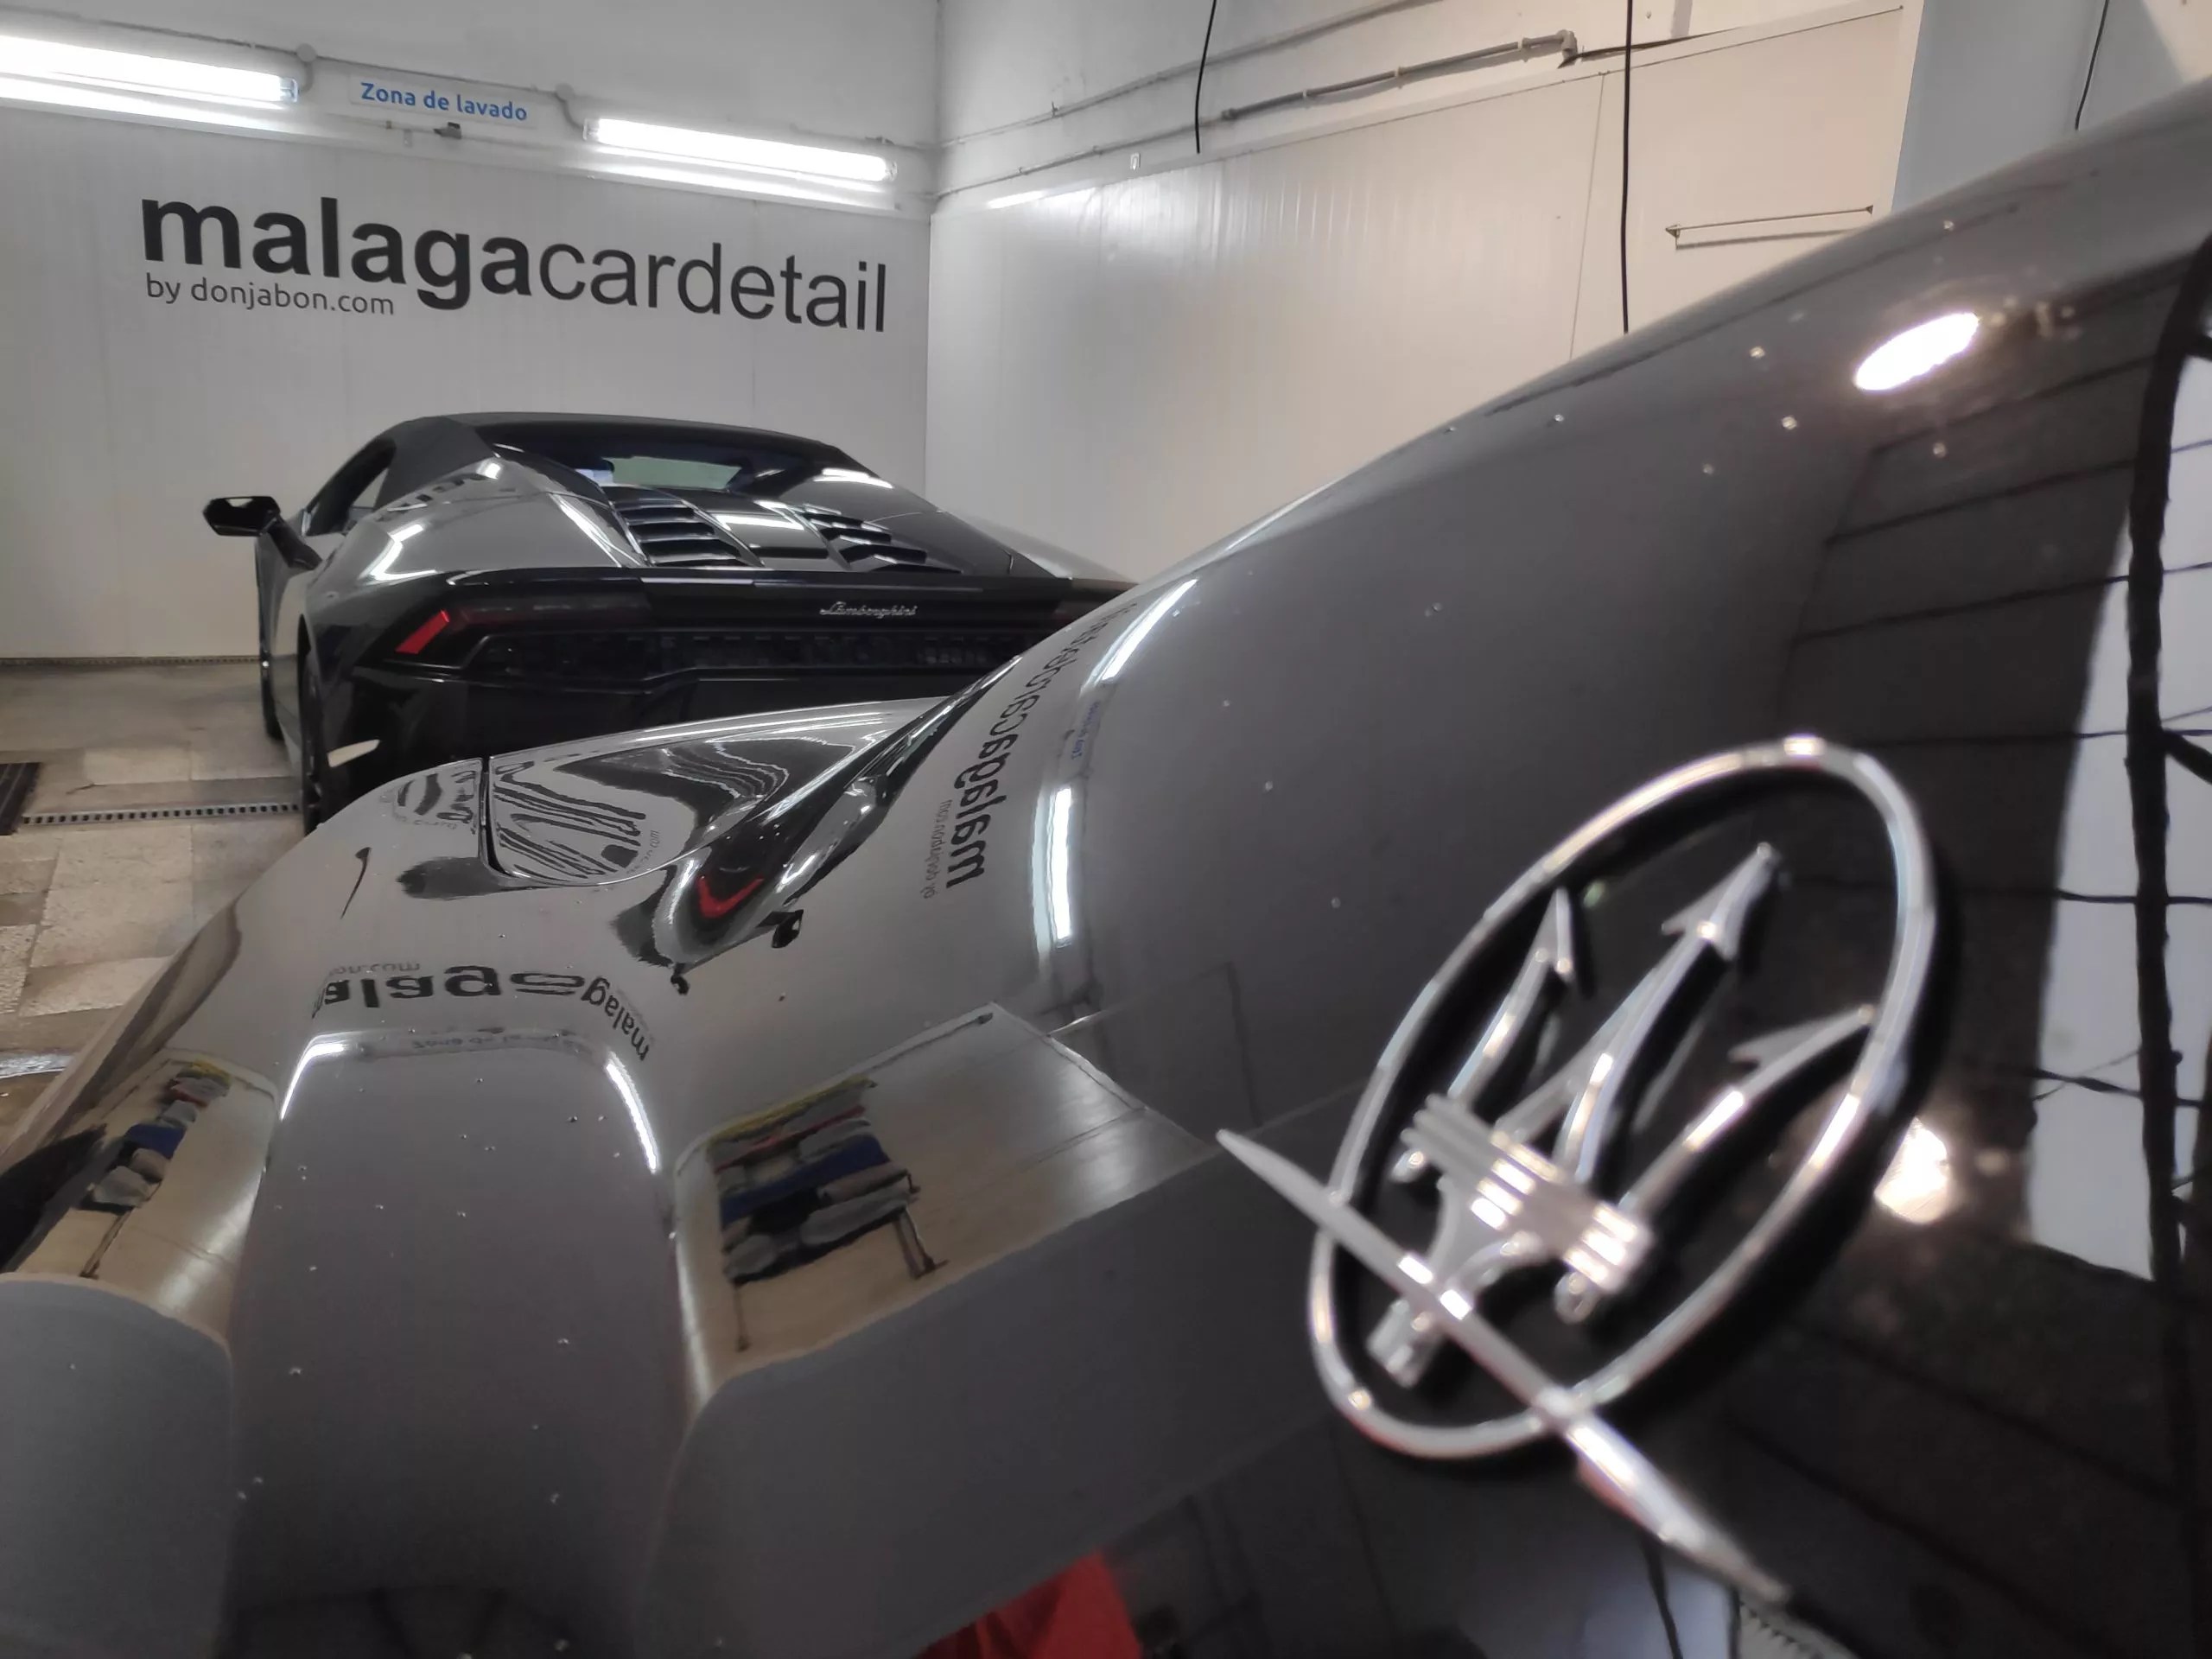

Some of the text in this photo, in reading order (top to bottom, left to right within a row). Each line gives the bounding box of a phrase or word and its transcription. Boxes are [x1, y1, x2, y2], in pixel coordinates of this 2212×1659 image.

[360, 82, 528, 121] Zona de lavado
[141, 197, 887, 333] malagacardetail
[145, 272, 394, 315] by donjabon.com
[819, 601, 918, 619] Lamborghini
